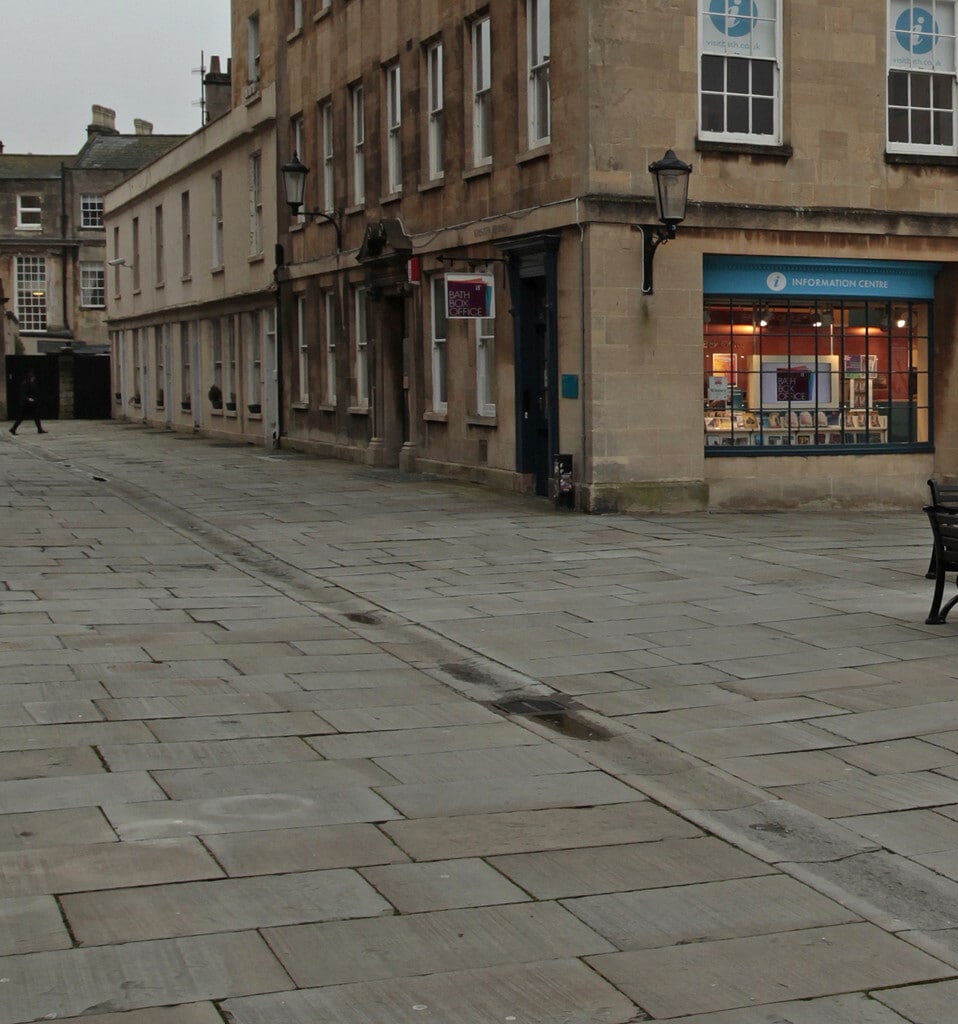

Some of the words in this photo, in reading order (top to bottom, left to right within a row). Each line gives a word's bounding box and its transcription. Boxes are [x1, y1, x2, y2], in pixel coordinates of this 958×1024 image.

[705, 39, 761, 50] visitbth.cok
[792, 278, 856, 288] INFORMATION
[858, 279, 889, 289] CENTRE
[448, 290, 471, 299] BATH
[448, 299, 469, 308] BOX
[448, 307, 484, 316] OFFICE
